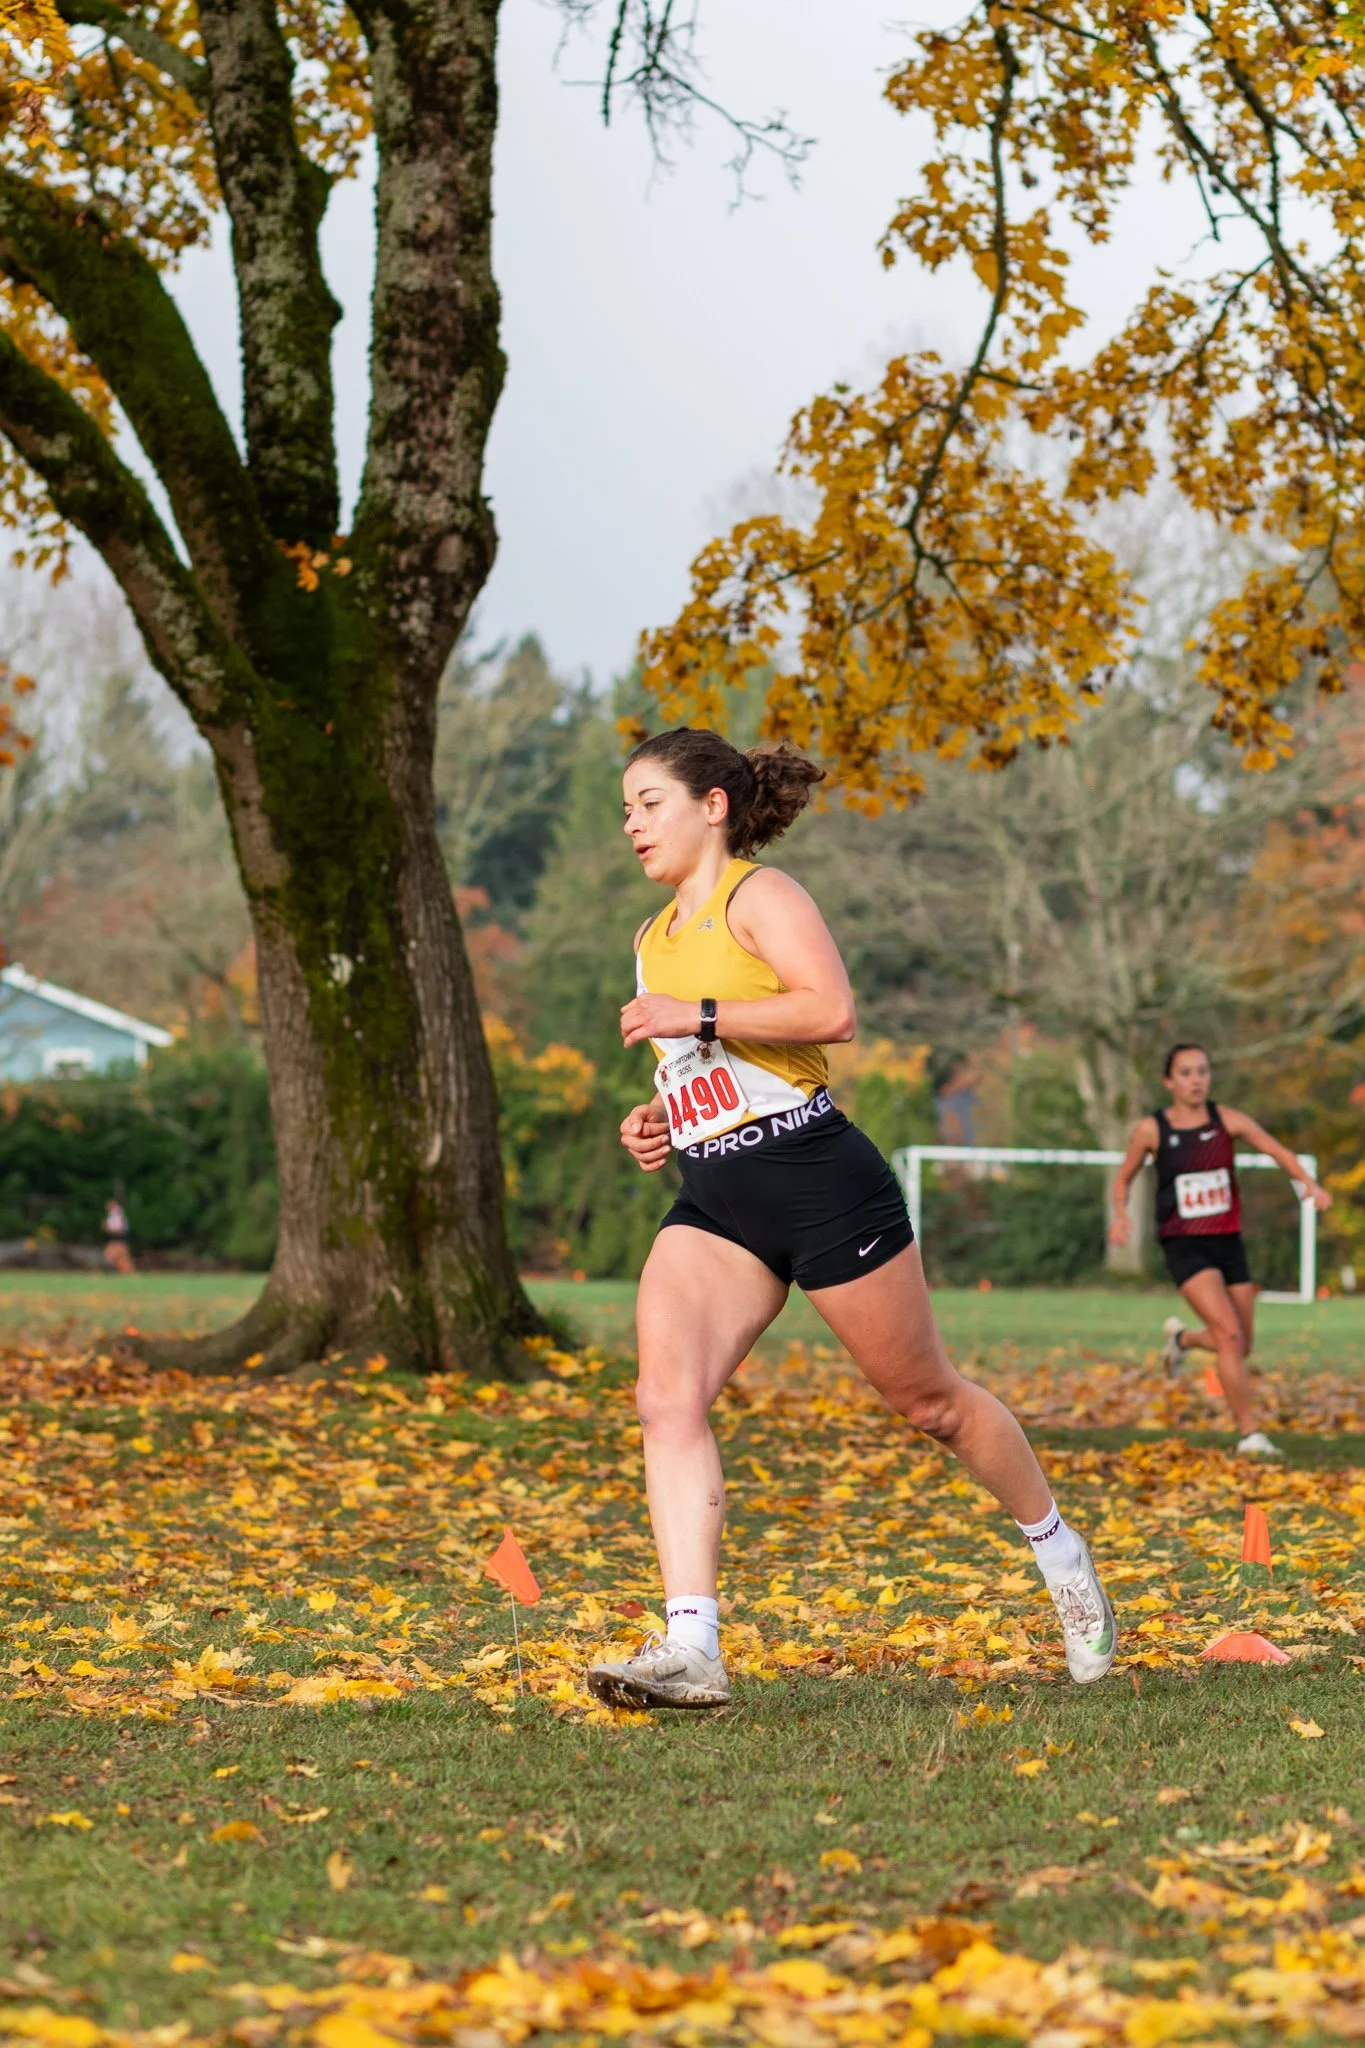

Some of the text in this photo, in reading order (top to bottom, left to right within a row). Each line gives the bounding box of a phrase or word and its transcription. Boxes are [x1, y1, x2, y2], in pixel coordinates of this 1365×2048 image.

[667, 1066, 740, 1135] 4490
[703, 1091, 832, 1158] PRO NIKE
